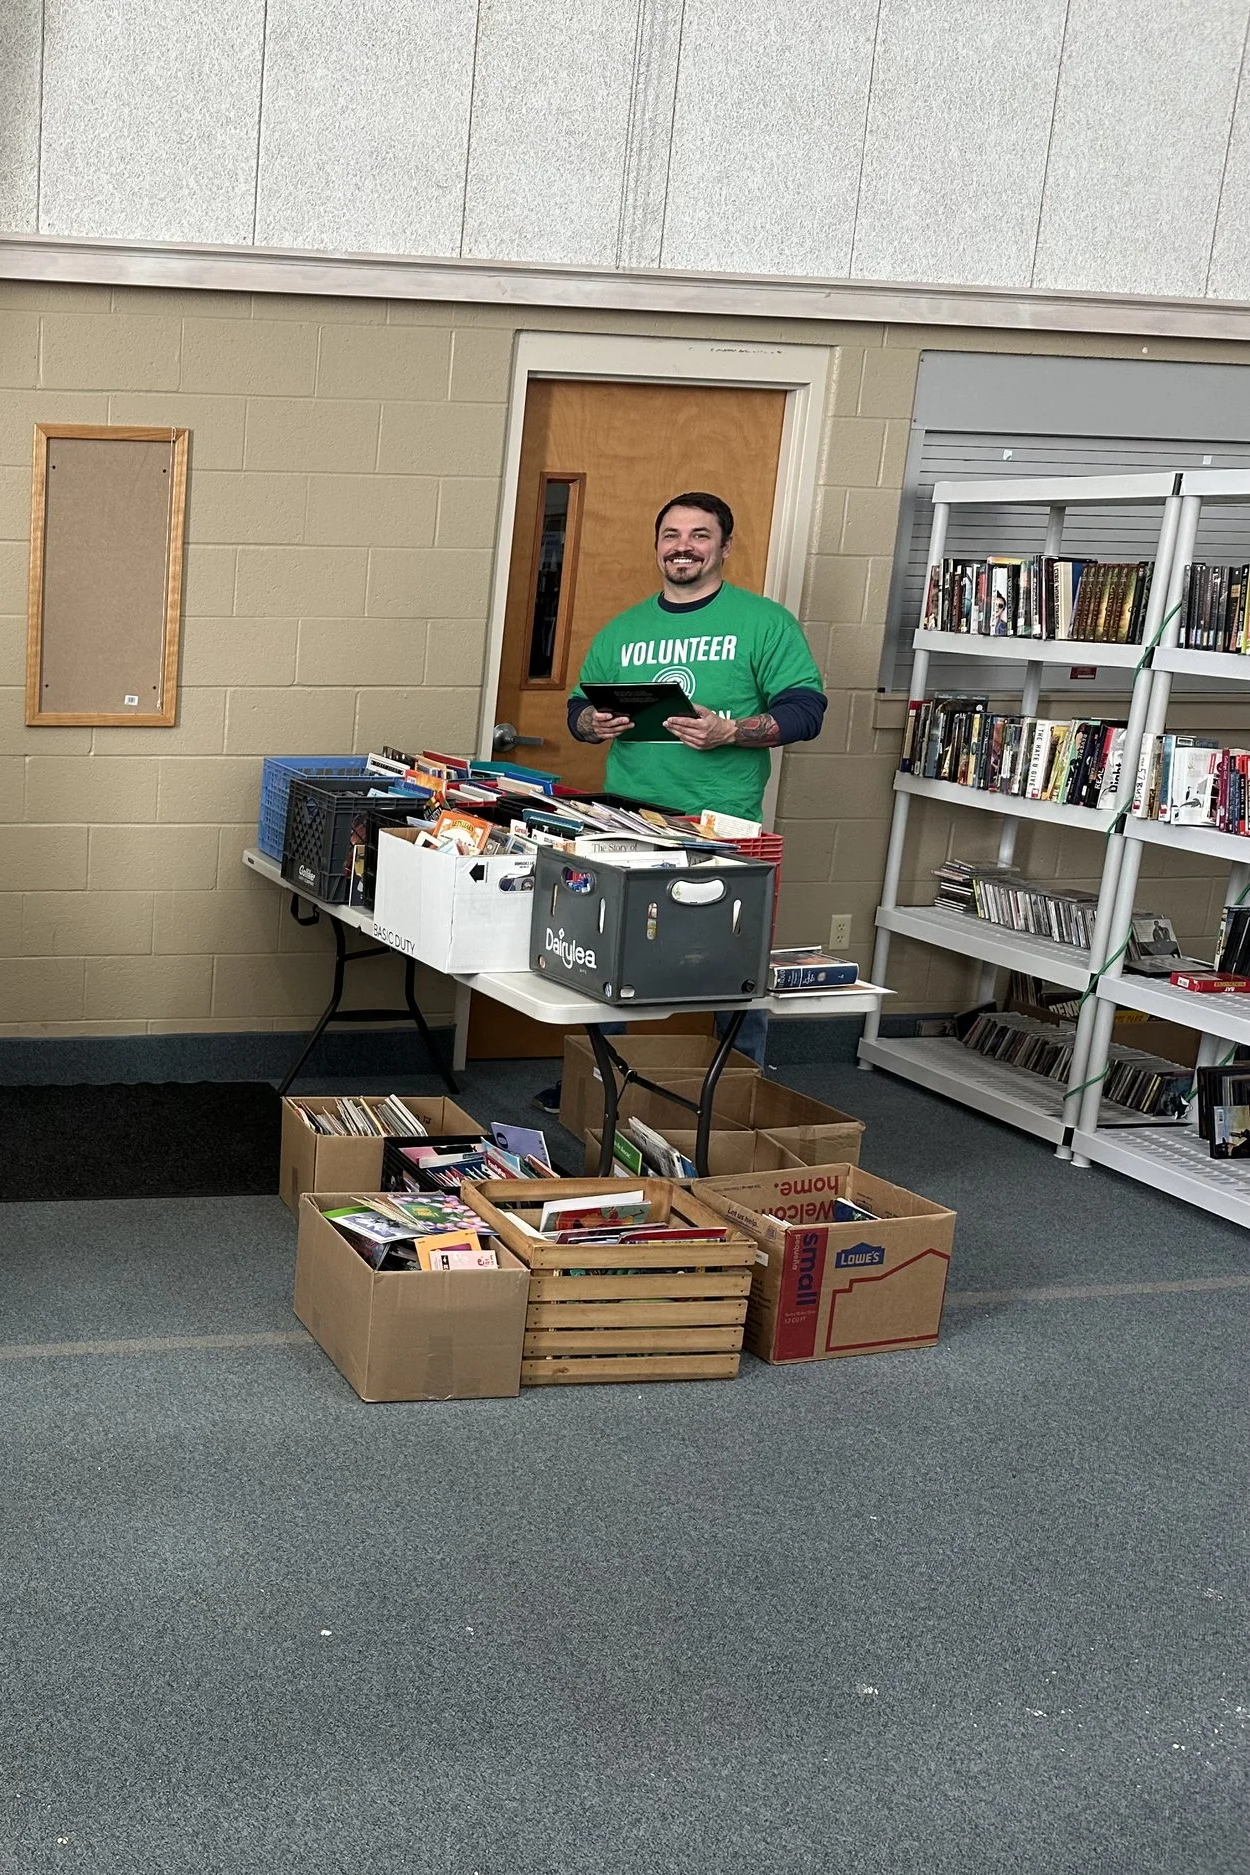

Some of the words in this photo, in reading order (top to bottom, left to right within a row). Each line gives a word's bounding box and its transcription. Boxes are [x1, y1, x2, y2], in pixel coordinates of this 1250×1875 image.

[621, 635, 738, 667] VOLUNTEER
[592, 843, 606, 853] The
[608, 842, 628, 853] Story
[630, 842, 639, 852] of
[373, 923, 395, 945] BASIC
[394, 935, 416, 955] DUTY
[545, 927, 598, 969] Dairylea
[773, 1175, 840, 1197] home.
[796, 1232, 819, 1306] small
[840, 1250, 881, 1266] LOWE'S
